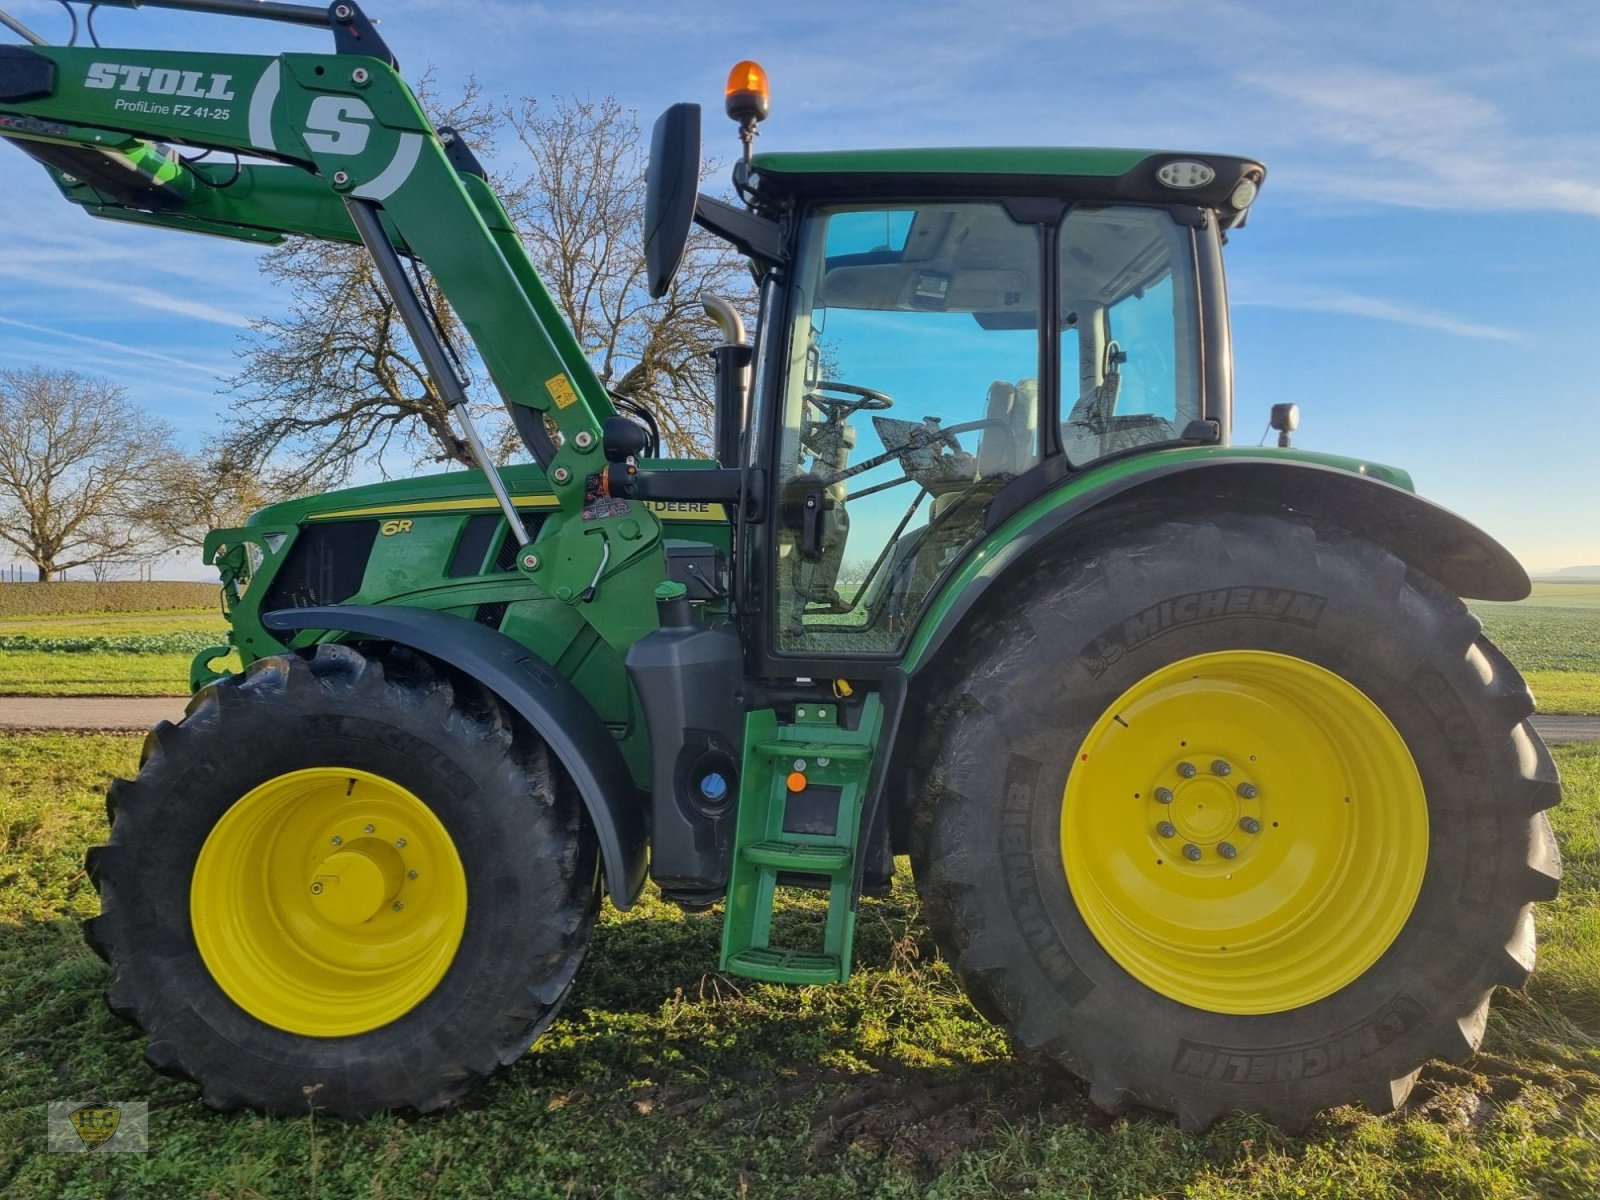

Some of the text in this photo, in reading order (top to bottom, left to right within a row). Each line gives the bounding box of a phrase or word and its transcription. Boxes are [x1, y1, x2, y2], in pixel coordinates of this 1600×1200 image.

[84, 62, 235, 101] STOLL
[114, 98, 231, 121] ProfiLine FZ 41-25
[302, 96, 375, 156] S
[654, 501, 709, 513] DEERE
[381, 519, 414, 536] 6R
[1124, 587, 1324, 645] MICHELIN
[1179, 1025, 1380, 1081] MICHELIN
